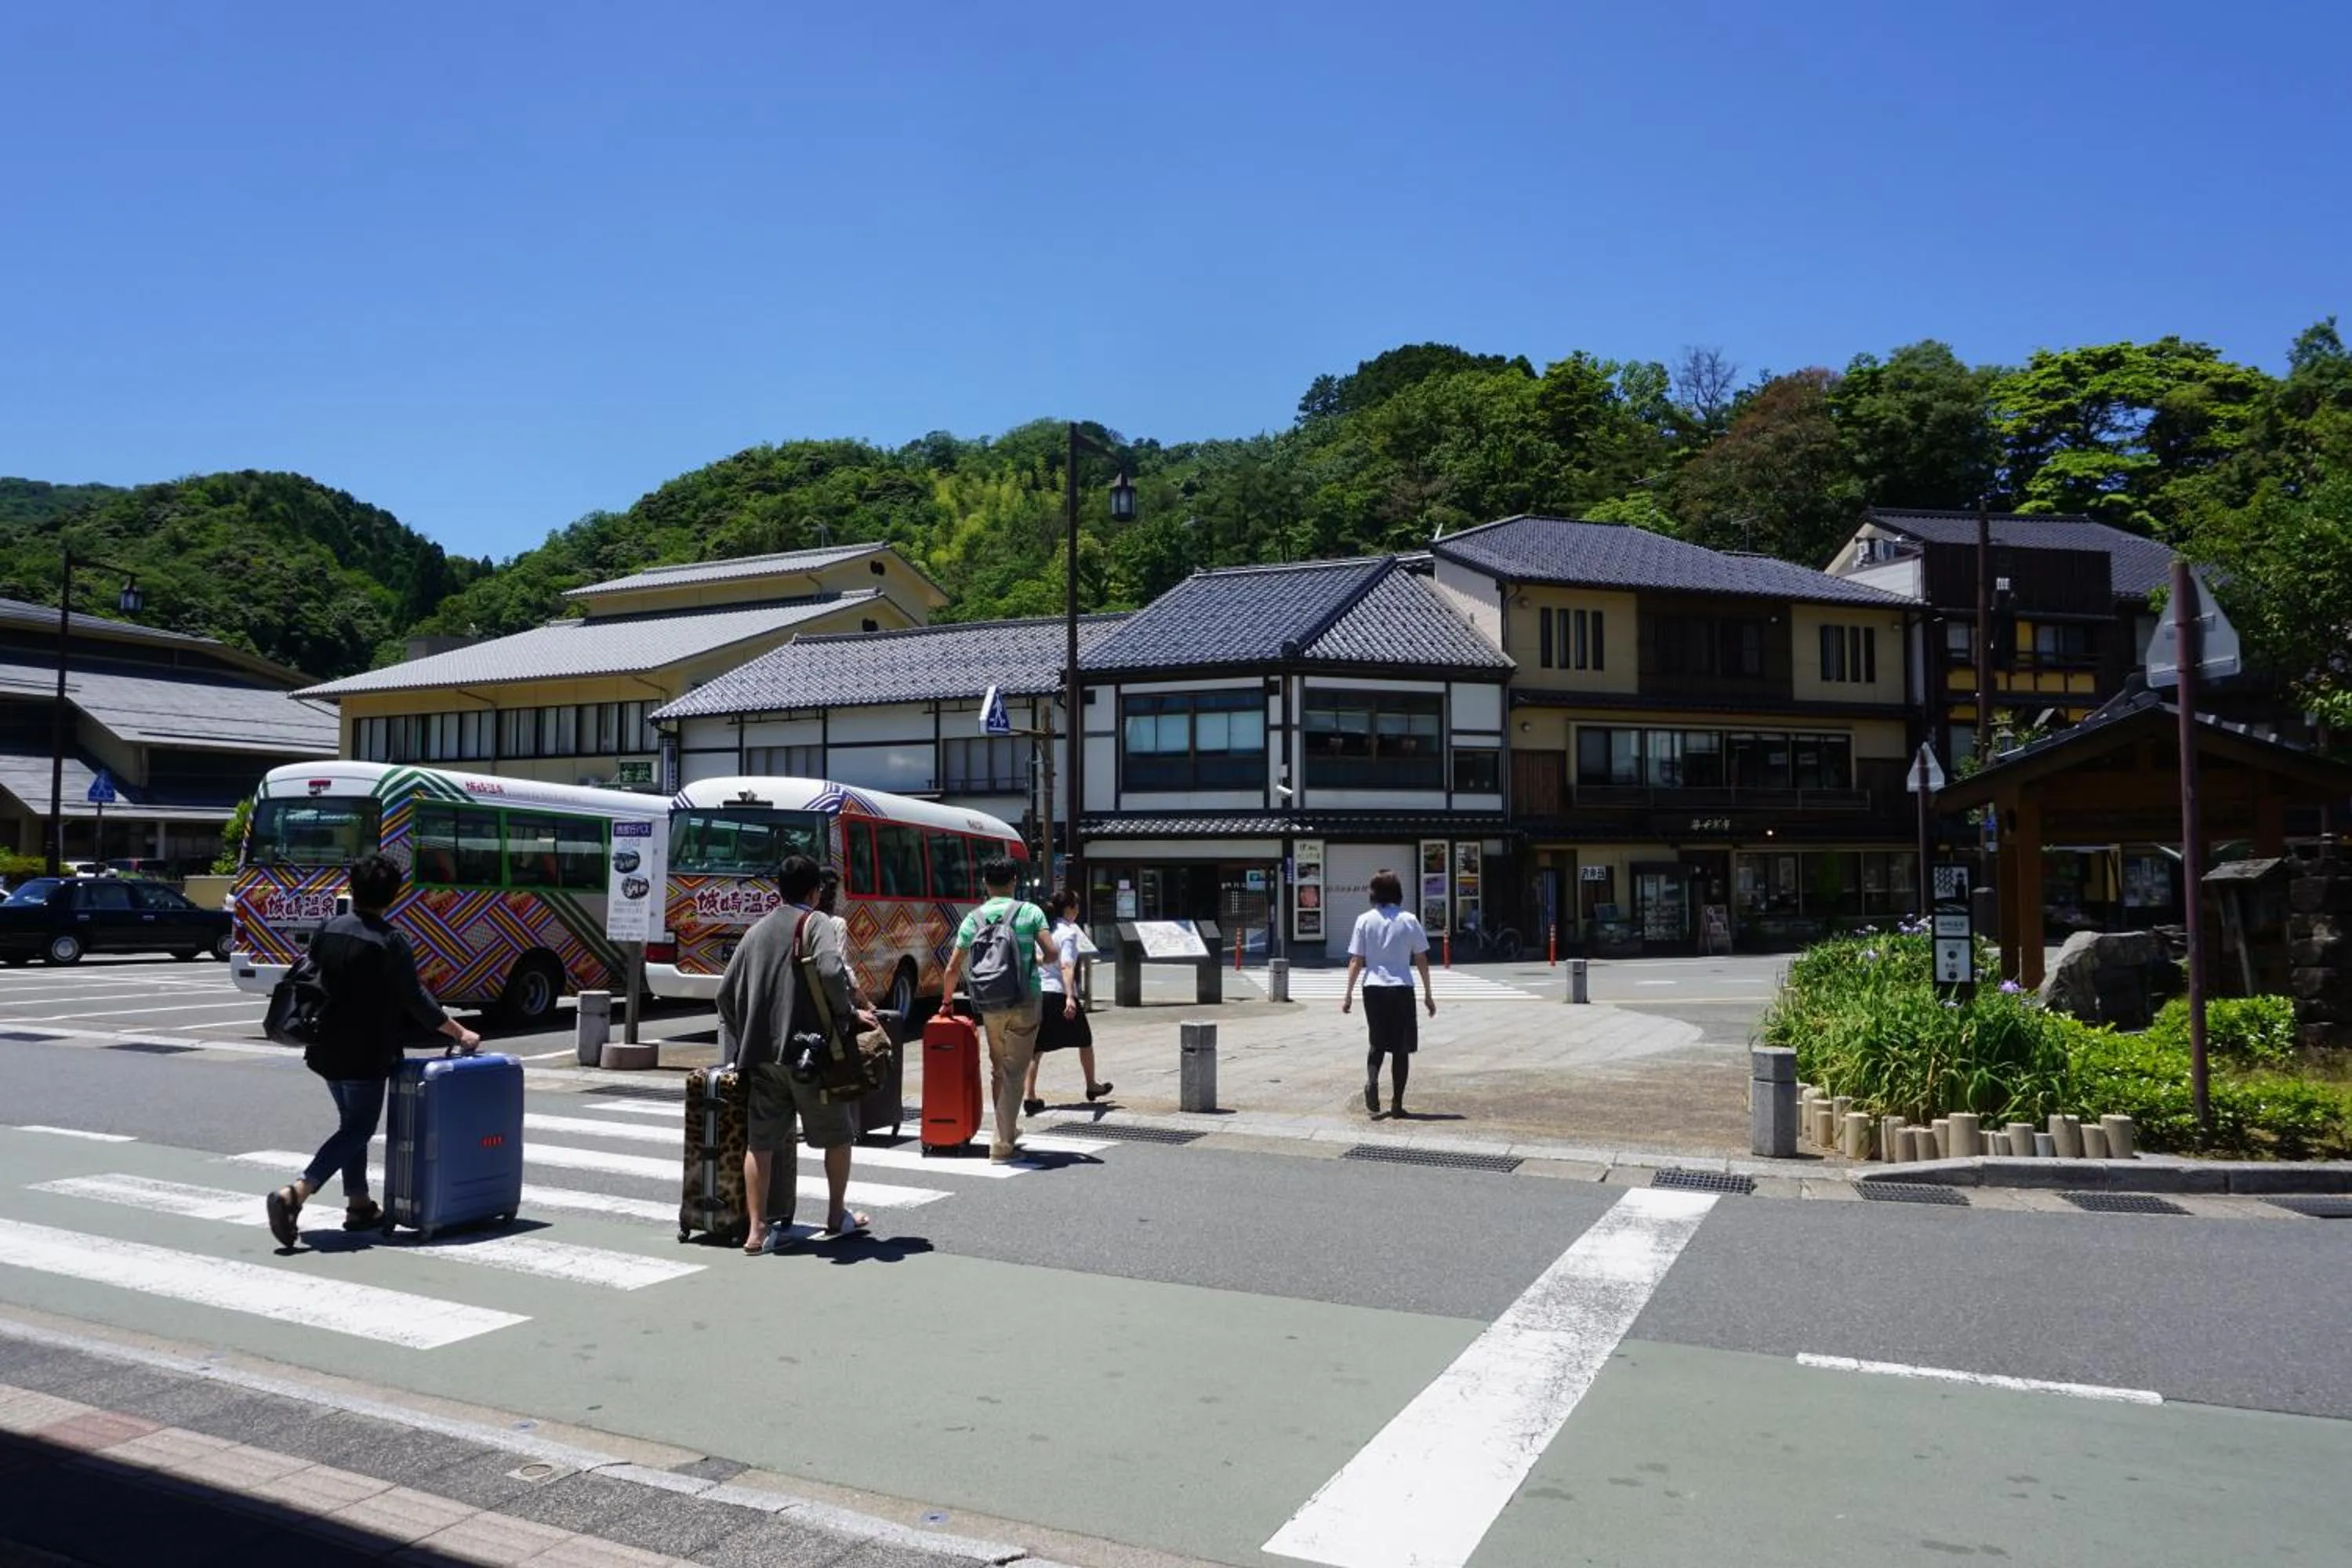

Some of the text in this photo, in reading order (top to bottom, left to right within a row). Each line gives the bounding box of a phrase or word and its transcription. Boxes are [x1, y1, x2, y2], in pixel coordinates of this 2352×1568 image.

[267, 894, 335, 917] 城崎温泉
[695, 889, 782, 913] 城崎温泉
